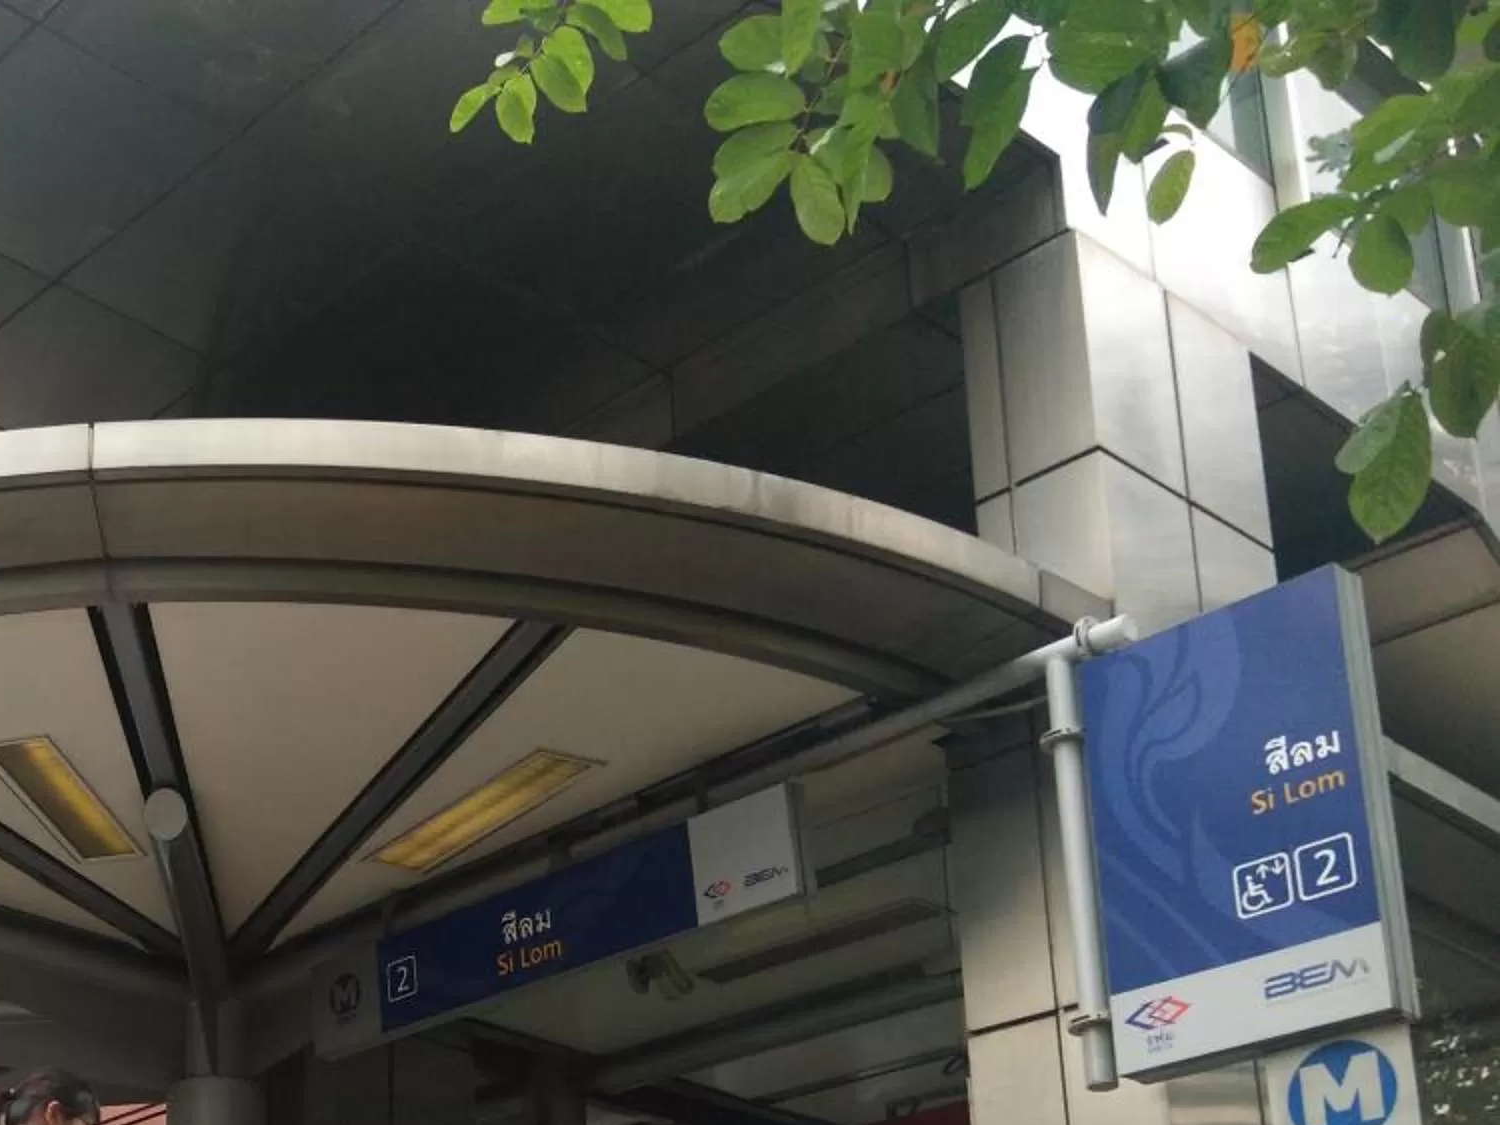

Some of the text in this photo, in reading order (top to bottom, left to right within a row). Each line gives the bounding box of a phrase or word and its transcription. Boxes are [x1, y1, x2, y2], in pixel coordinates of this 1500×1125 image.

[1264, 730, 1341, 775] สีลม
[1252, 770, 1346, 815] Si Lom
[1313, 849, 1340, 886] 2
[501, 908, 552, 945] สีลม
[497, 940, 563, 976] Si Lom
[395, 966, 410, 992] 2
